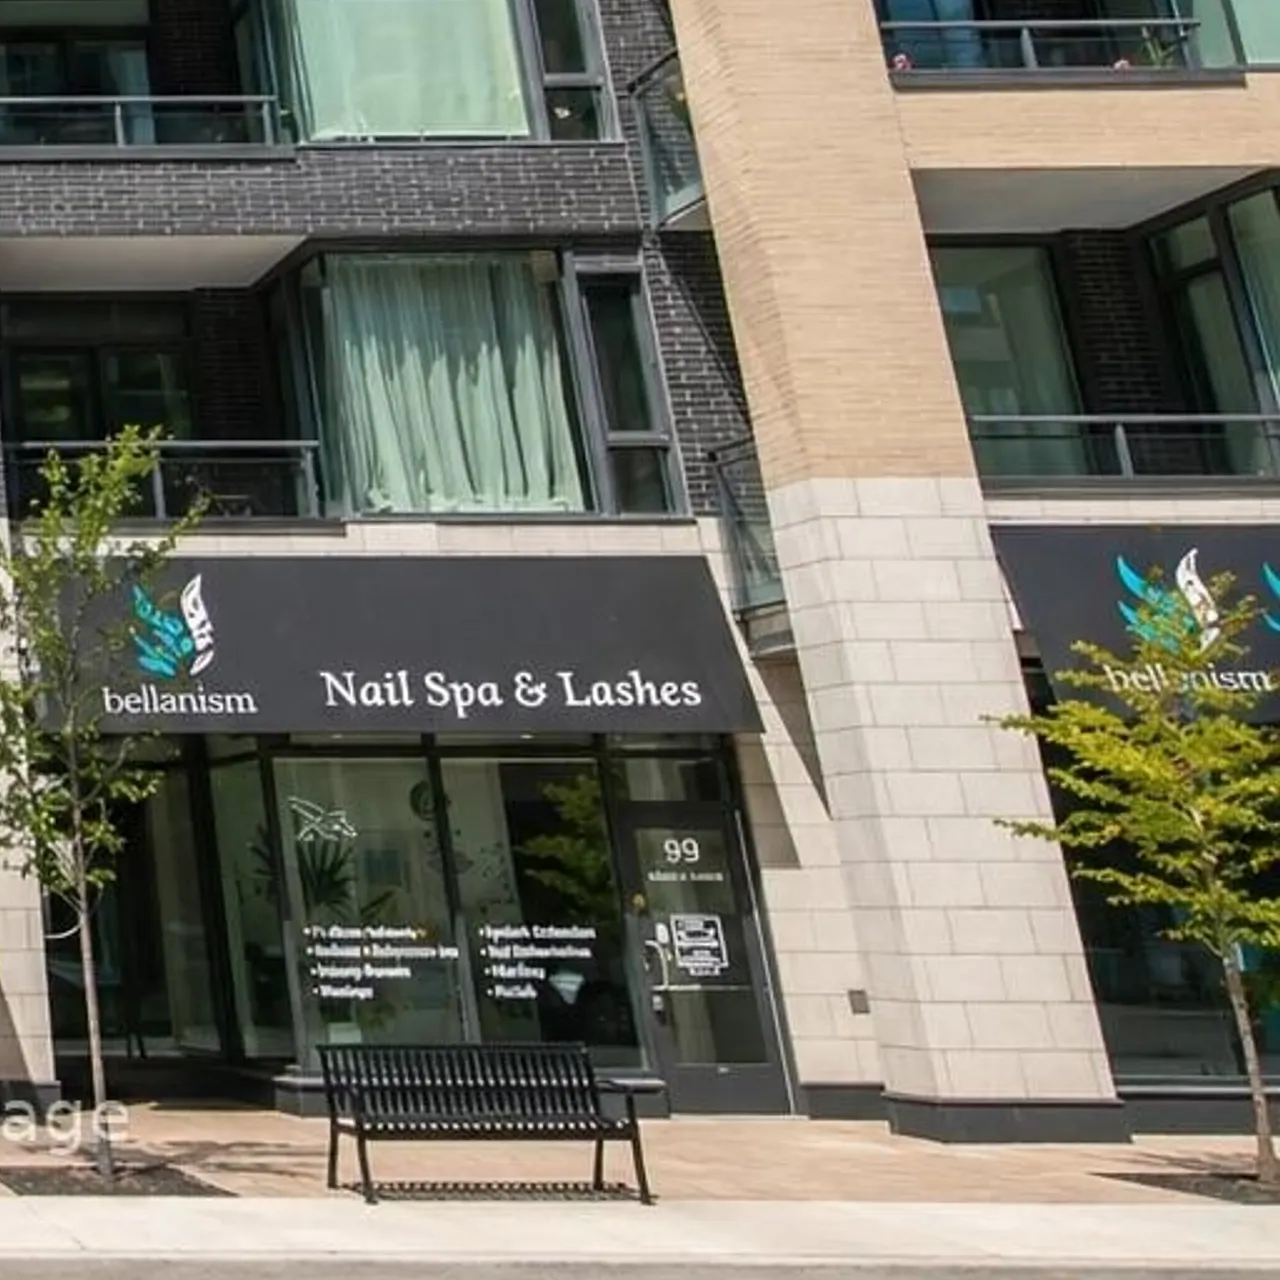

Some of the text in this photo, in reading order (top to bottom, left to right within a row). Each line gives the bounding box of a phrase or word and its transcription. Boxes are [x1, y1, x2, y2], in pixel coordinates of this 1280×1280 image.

[1101, 661, 1278, 693] bellnism
[102, 686, 259, 715] bellanism
[320, 668, 703, 718] Nail Spa & Lashes
[664, 837, 700, 863] 99
